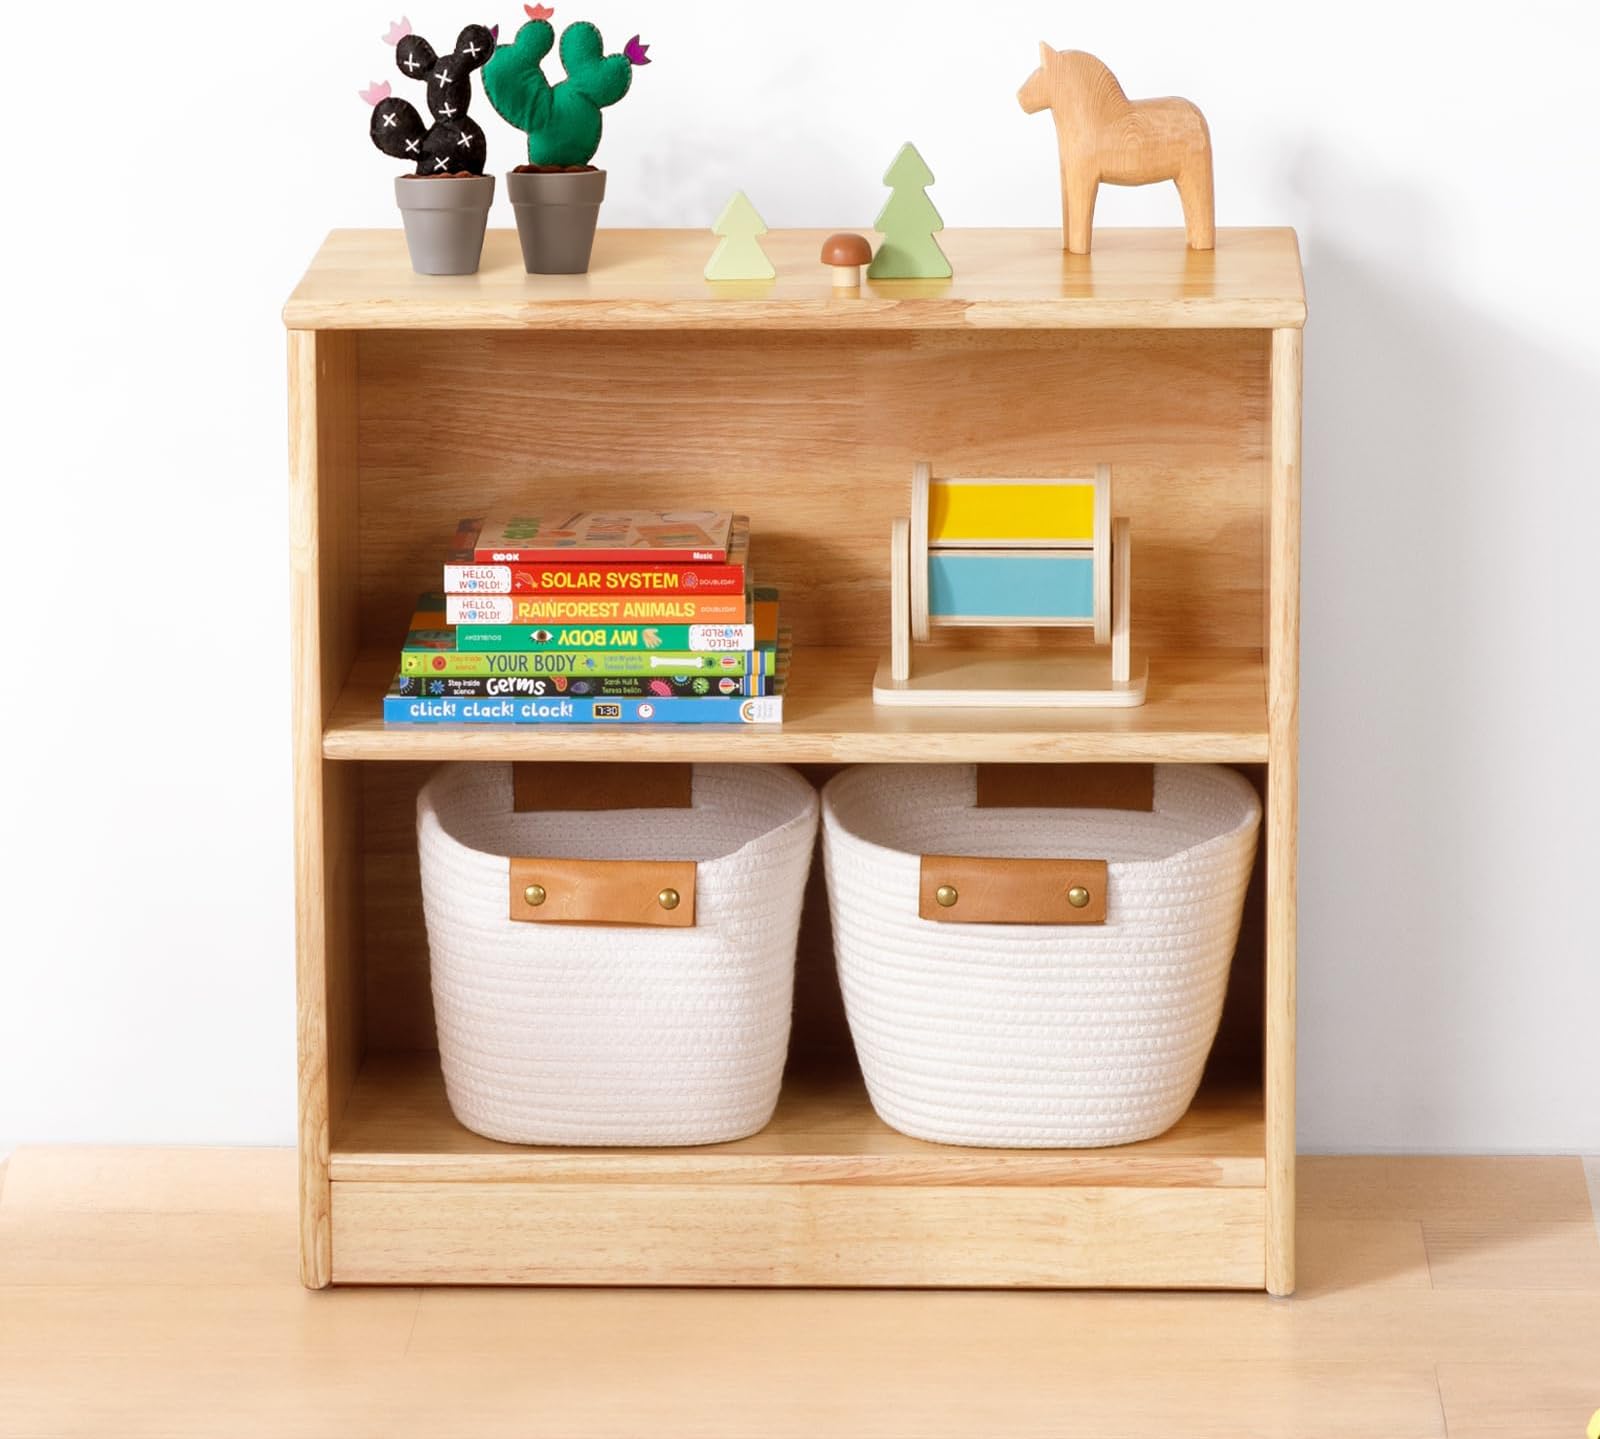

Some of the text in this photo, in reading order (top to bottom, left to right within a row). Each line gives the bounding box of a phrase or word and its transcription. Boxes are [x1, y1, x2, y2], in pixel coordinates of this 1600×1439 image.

[693, 552, 713, 560] Music
[462, 570, 496, 579] HELLO,
[541, 572, 679, 588] SOLAR SYSTEM
[462, 601, 496, 610] HELLO,
[518, 602, 696, 617] RAINFOREST ANIMALS
[558, 630, 638, 646] MY BODY
[706, 638, 739, 647] HELLO,
[486, 655, 577, 672] YOUR BODY
[448, 680, 461, 690] Step
[486, 677, 546, 695] Germs
[410, 701, 574, 717] click! clack! clock!
[597, 706, 618, 716] 7:30
